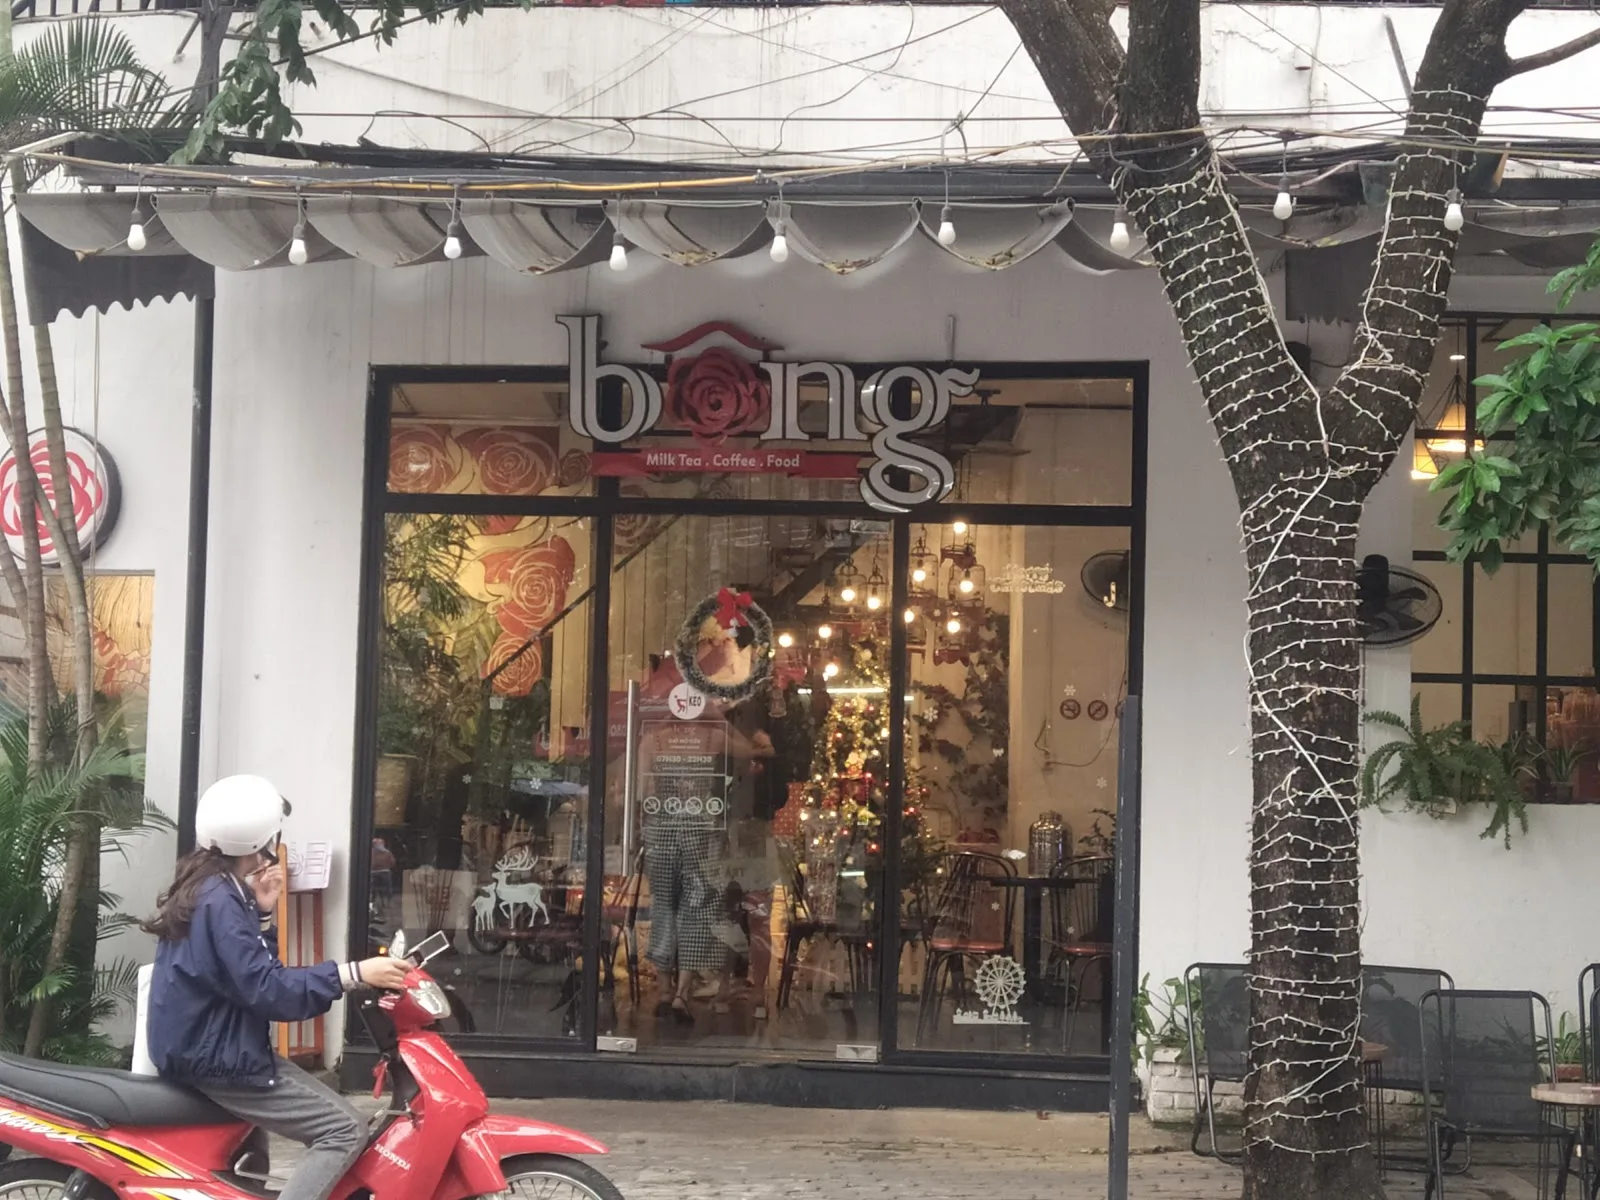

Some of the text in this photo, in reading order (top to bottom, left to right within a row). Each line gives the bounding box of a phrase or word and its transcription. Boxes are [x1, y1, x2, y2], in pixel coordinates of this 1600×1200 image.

[646, 453, 676, 466] Milk
[679, 453, 702, 467] Tea
[713, 454, 756, 467] Coffee
[767, 454, 800, 467] Food
[374, 1143, 411, 1171] HONDA
